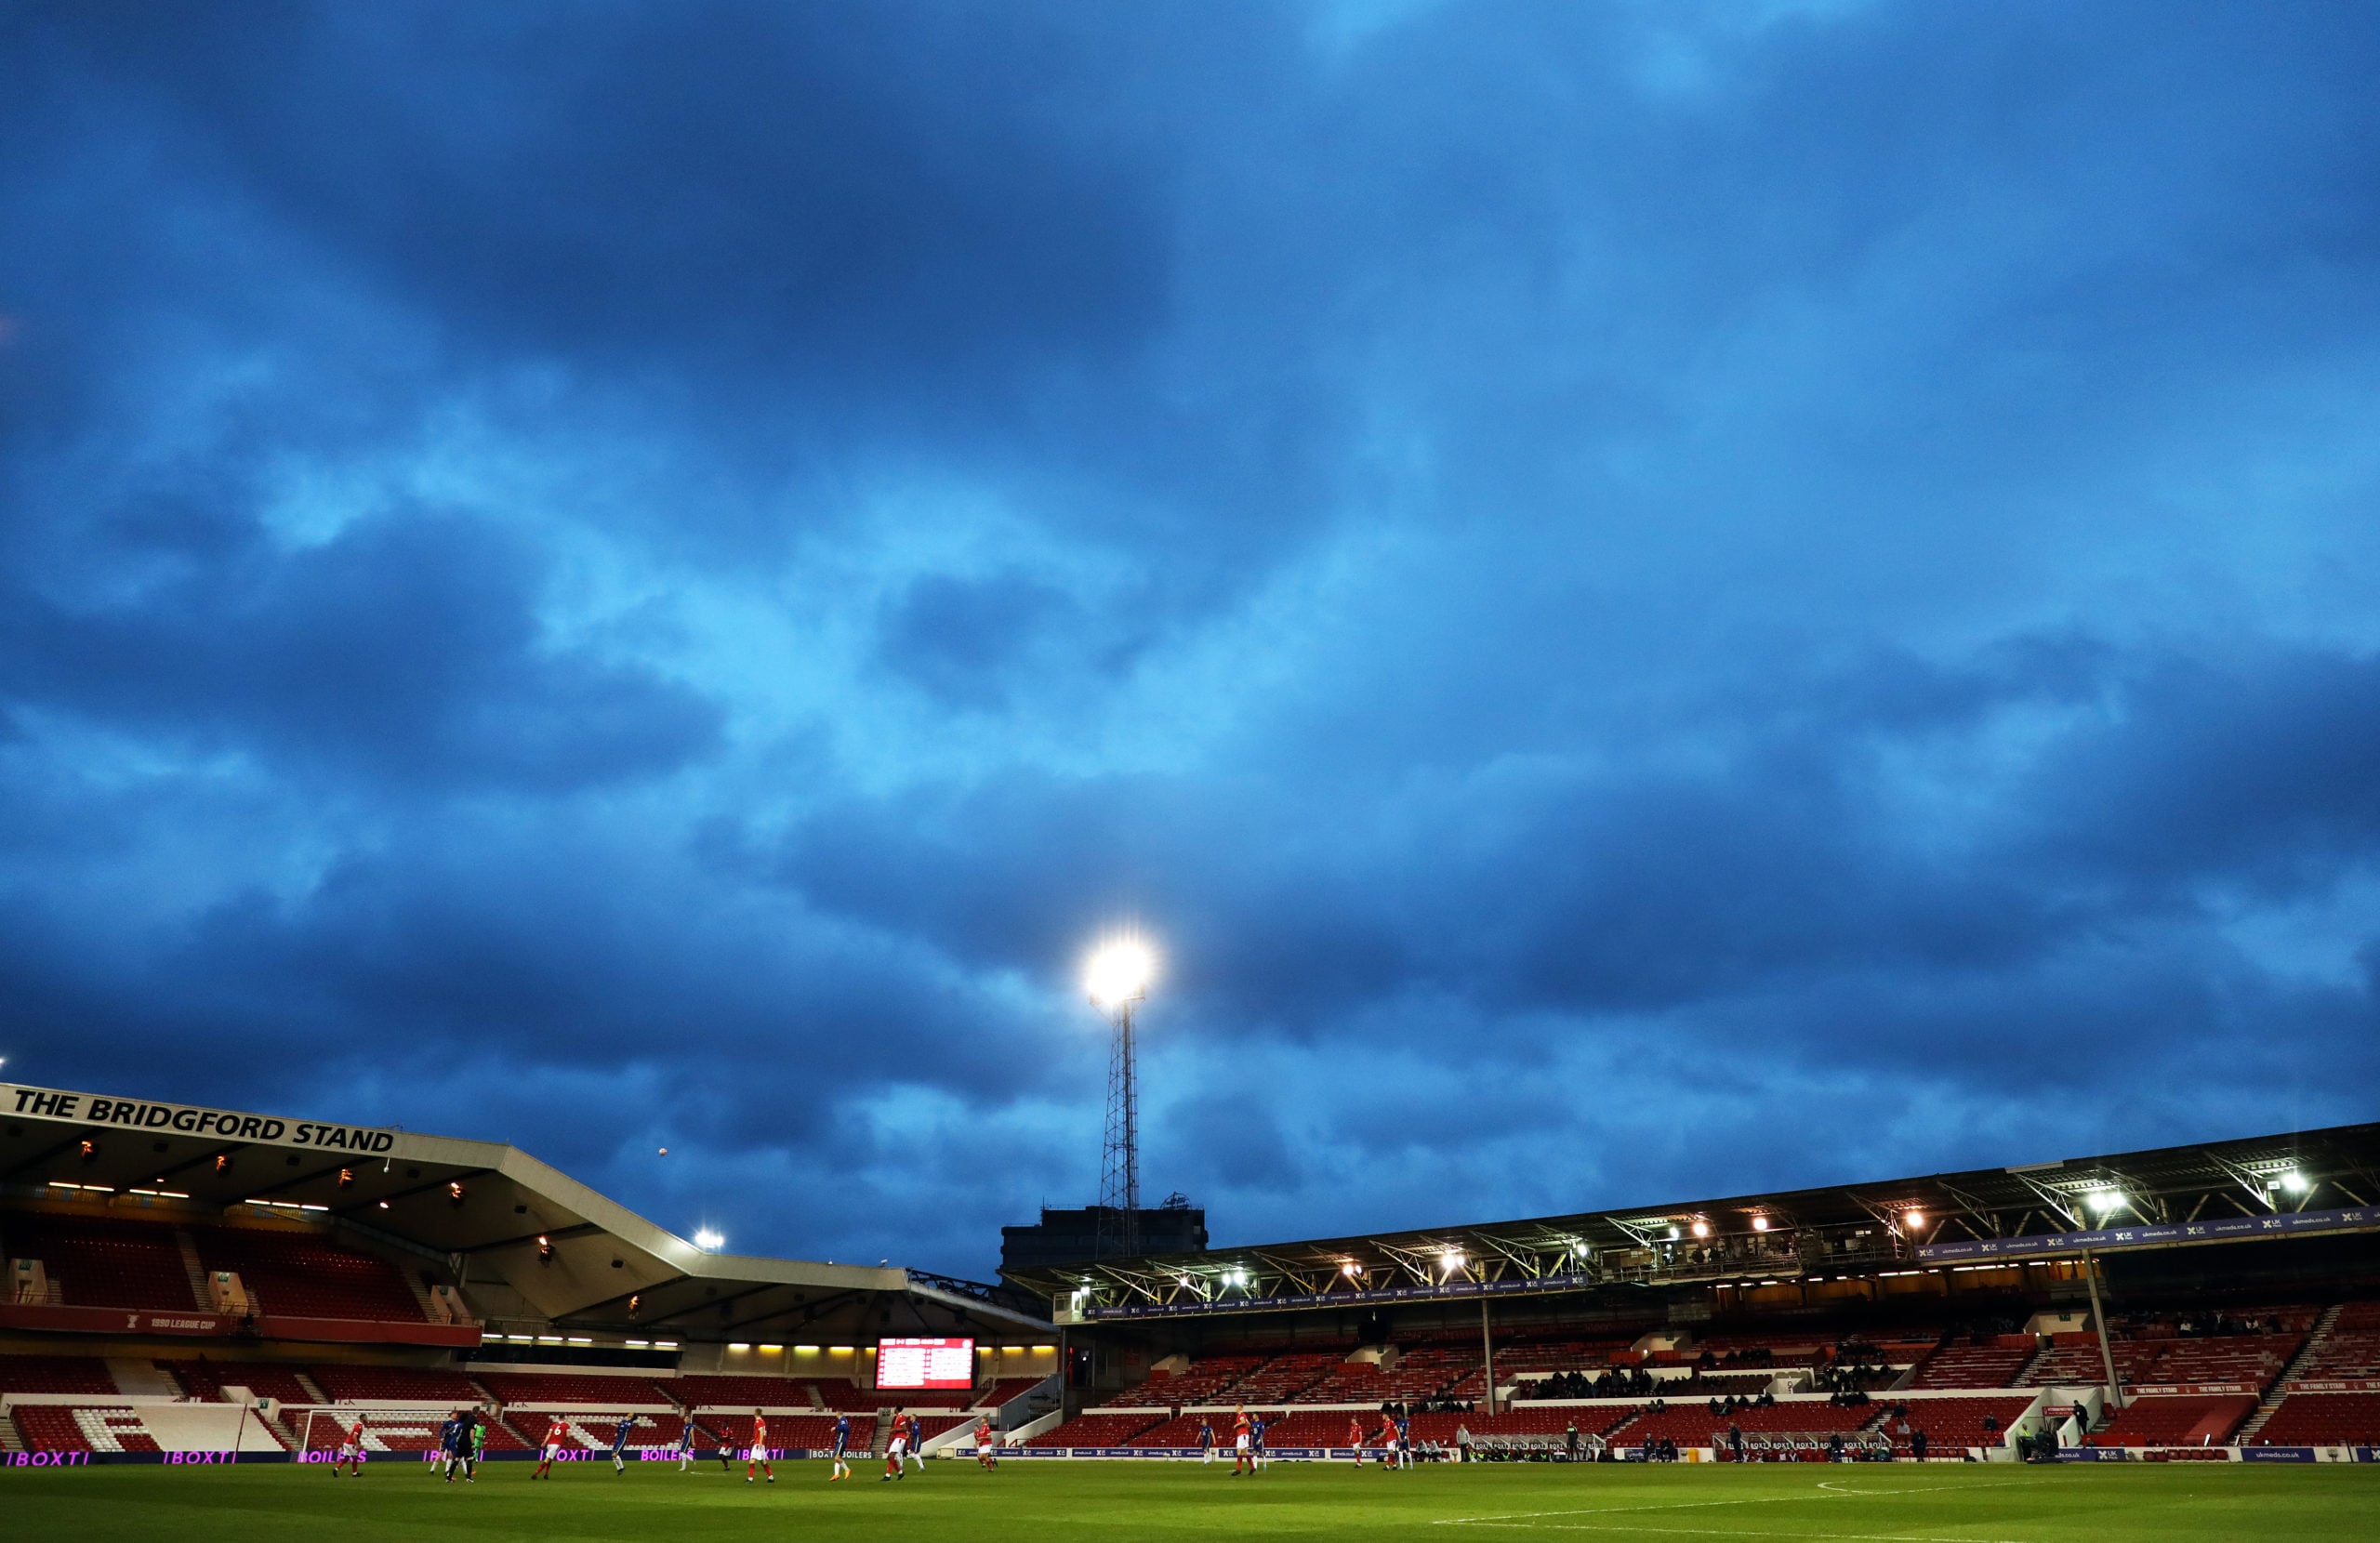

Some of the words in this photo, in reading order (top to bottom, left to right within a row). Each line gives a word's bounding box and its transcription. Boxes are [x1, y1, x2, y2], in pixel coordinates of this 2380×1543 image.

[15, 1089, 79, 1117] THE
[86, 1099, 284, 1141] BRIDGFORD
[294, 1123, 393, 1153] STAND
[151, 1318, 170, 1328] 1990
[171, 1319, 200, 1329] LEAGUE
[200, 1320, 216, 1330] CUP
[555, 1425, 561, 1435] 6
[298, 1451, 367, 1463] BOILES
[556, 1450, 589, 1461] OXT
[742, 1449, 779, 1460] BXT
